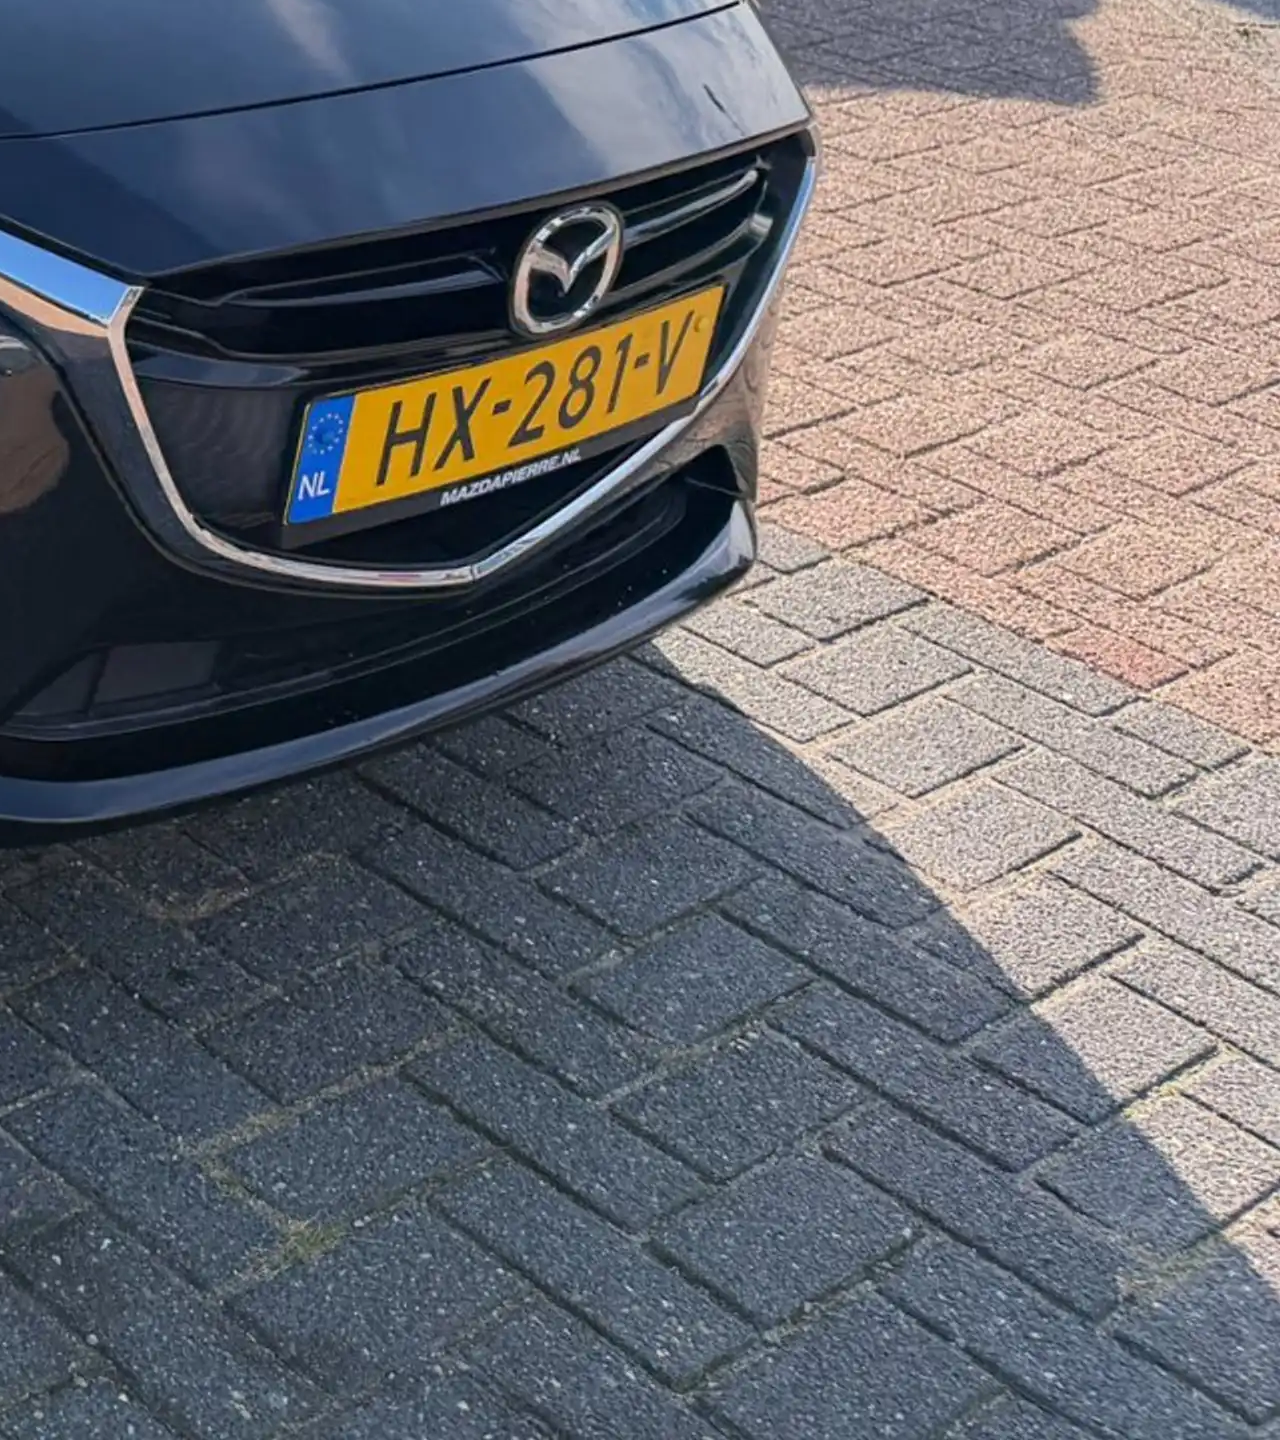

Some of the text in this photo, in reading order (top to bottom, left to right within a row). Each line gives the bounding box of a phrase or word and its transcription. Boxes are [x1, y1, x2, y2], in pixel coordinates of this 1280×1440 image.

[376, 310, 694, 487] HX-281-V
[297, 469, 330, 502] NL
[441, 448, 582, 507] MAZDAPIERRE.NL
